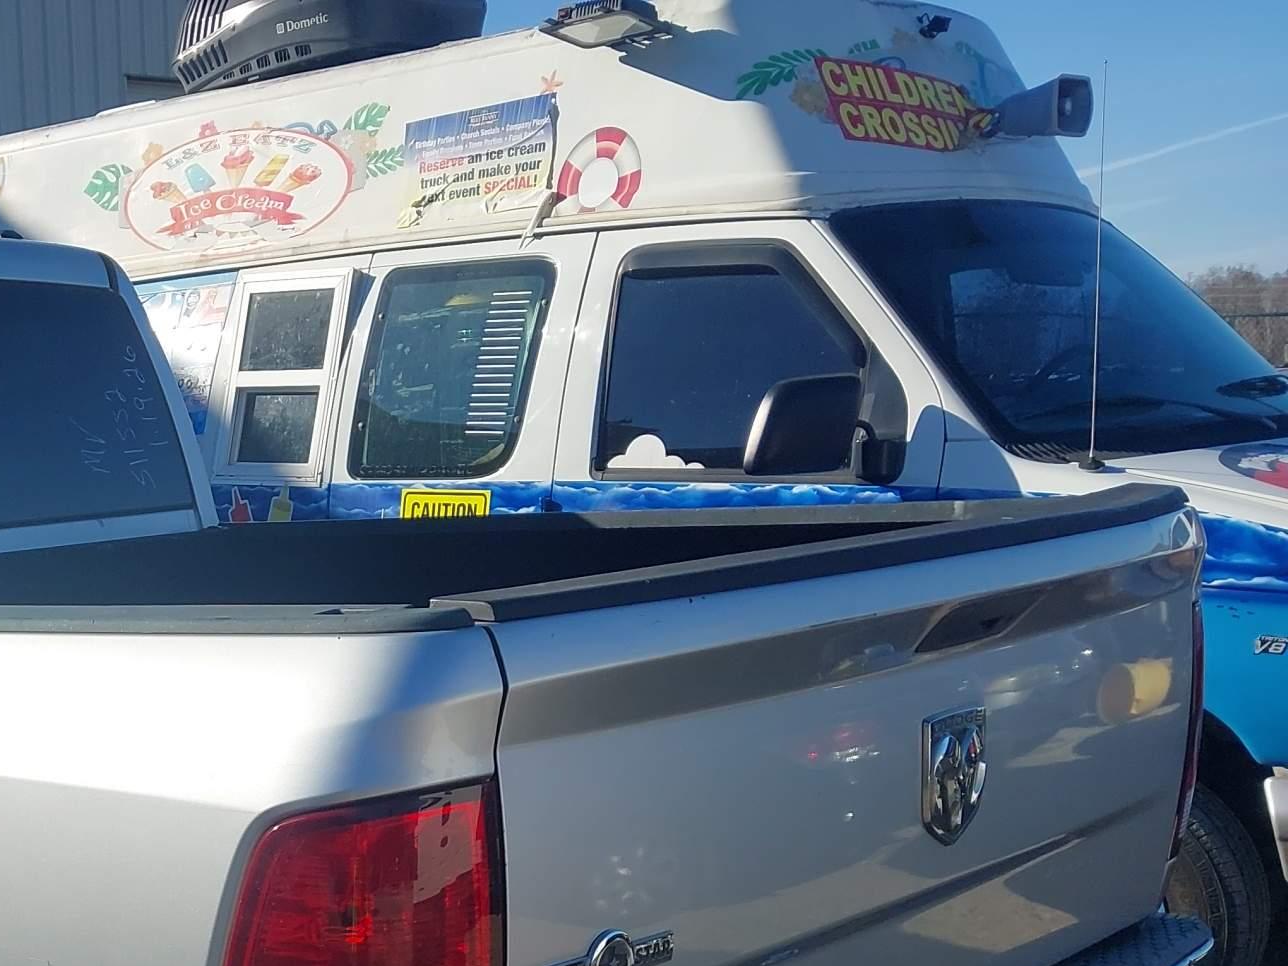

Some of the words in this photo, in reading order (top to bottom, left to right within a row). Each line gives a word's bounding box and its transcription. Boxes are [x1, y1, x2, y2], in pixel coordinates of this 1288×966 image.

[286, 13, 329, 32] Dometic
[419, 157, 464, 174] Reserve
[468, 153, 482, 165] an
[485, 149, 503, 161] ice
[507, 142, 545, 157] cream
[420, 174, 452, 189] truck
[453, 168, 475, 182] and
[478, 163, 511, 179] make
[515, 160, 542, 178] your
[449, 184, 480, 200] event
[179, 199, 212, 223] Ice
[215, 191, 285, 212] Cream
[411, 502, 478, 518] CAUTION
[1254, 639, 1287, 654] V8
